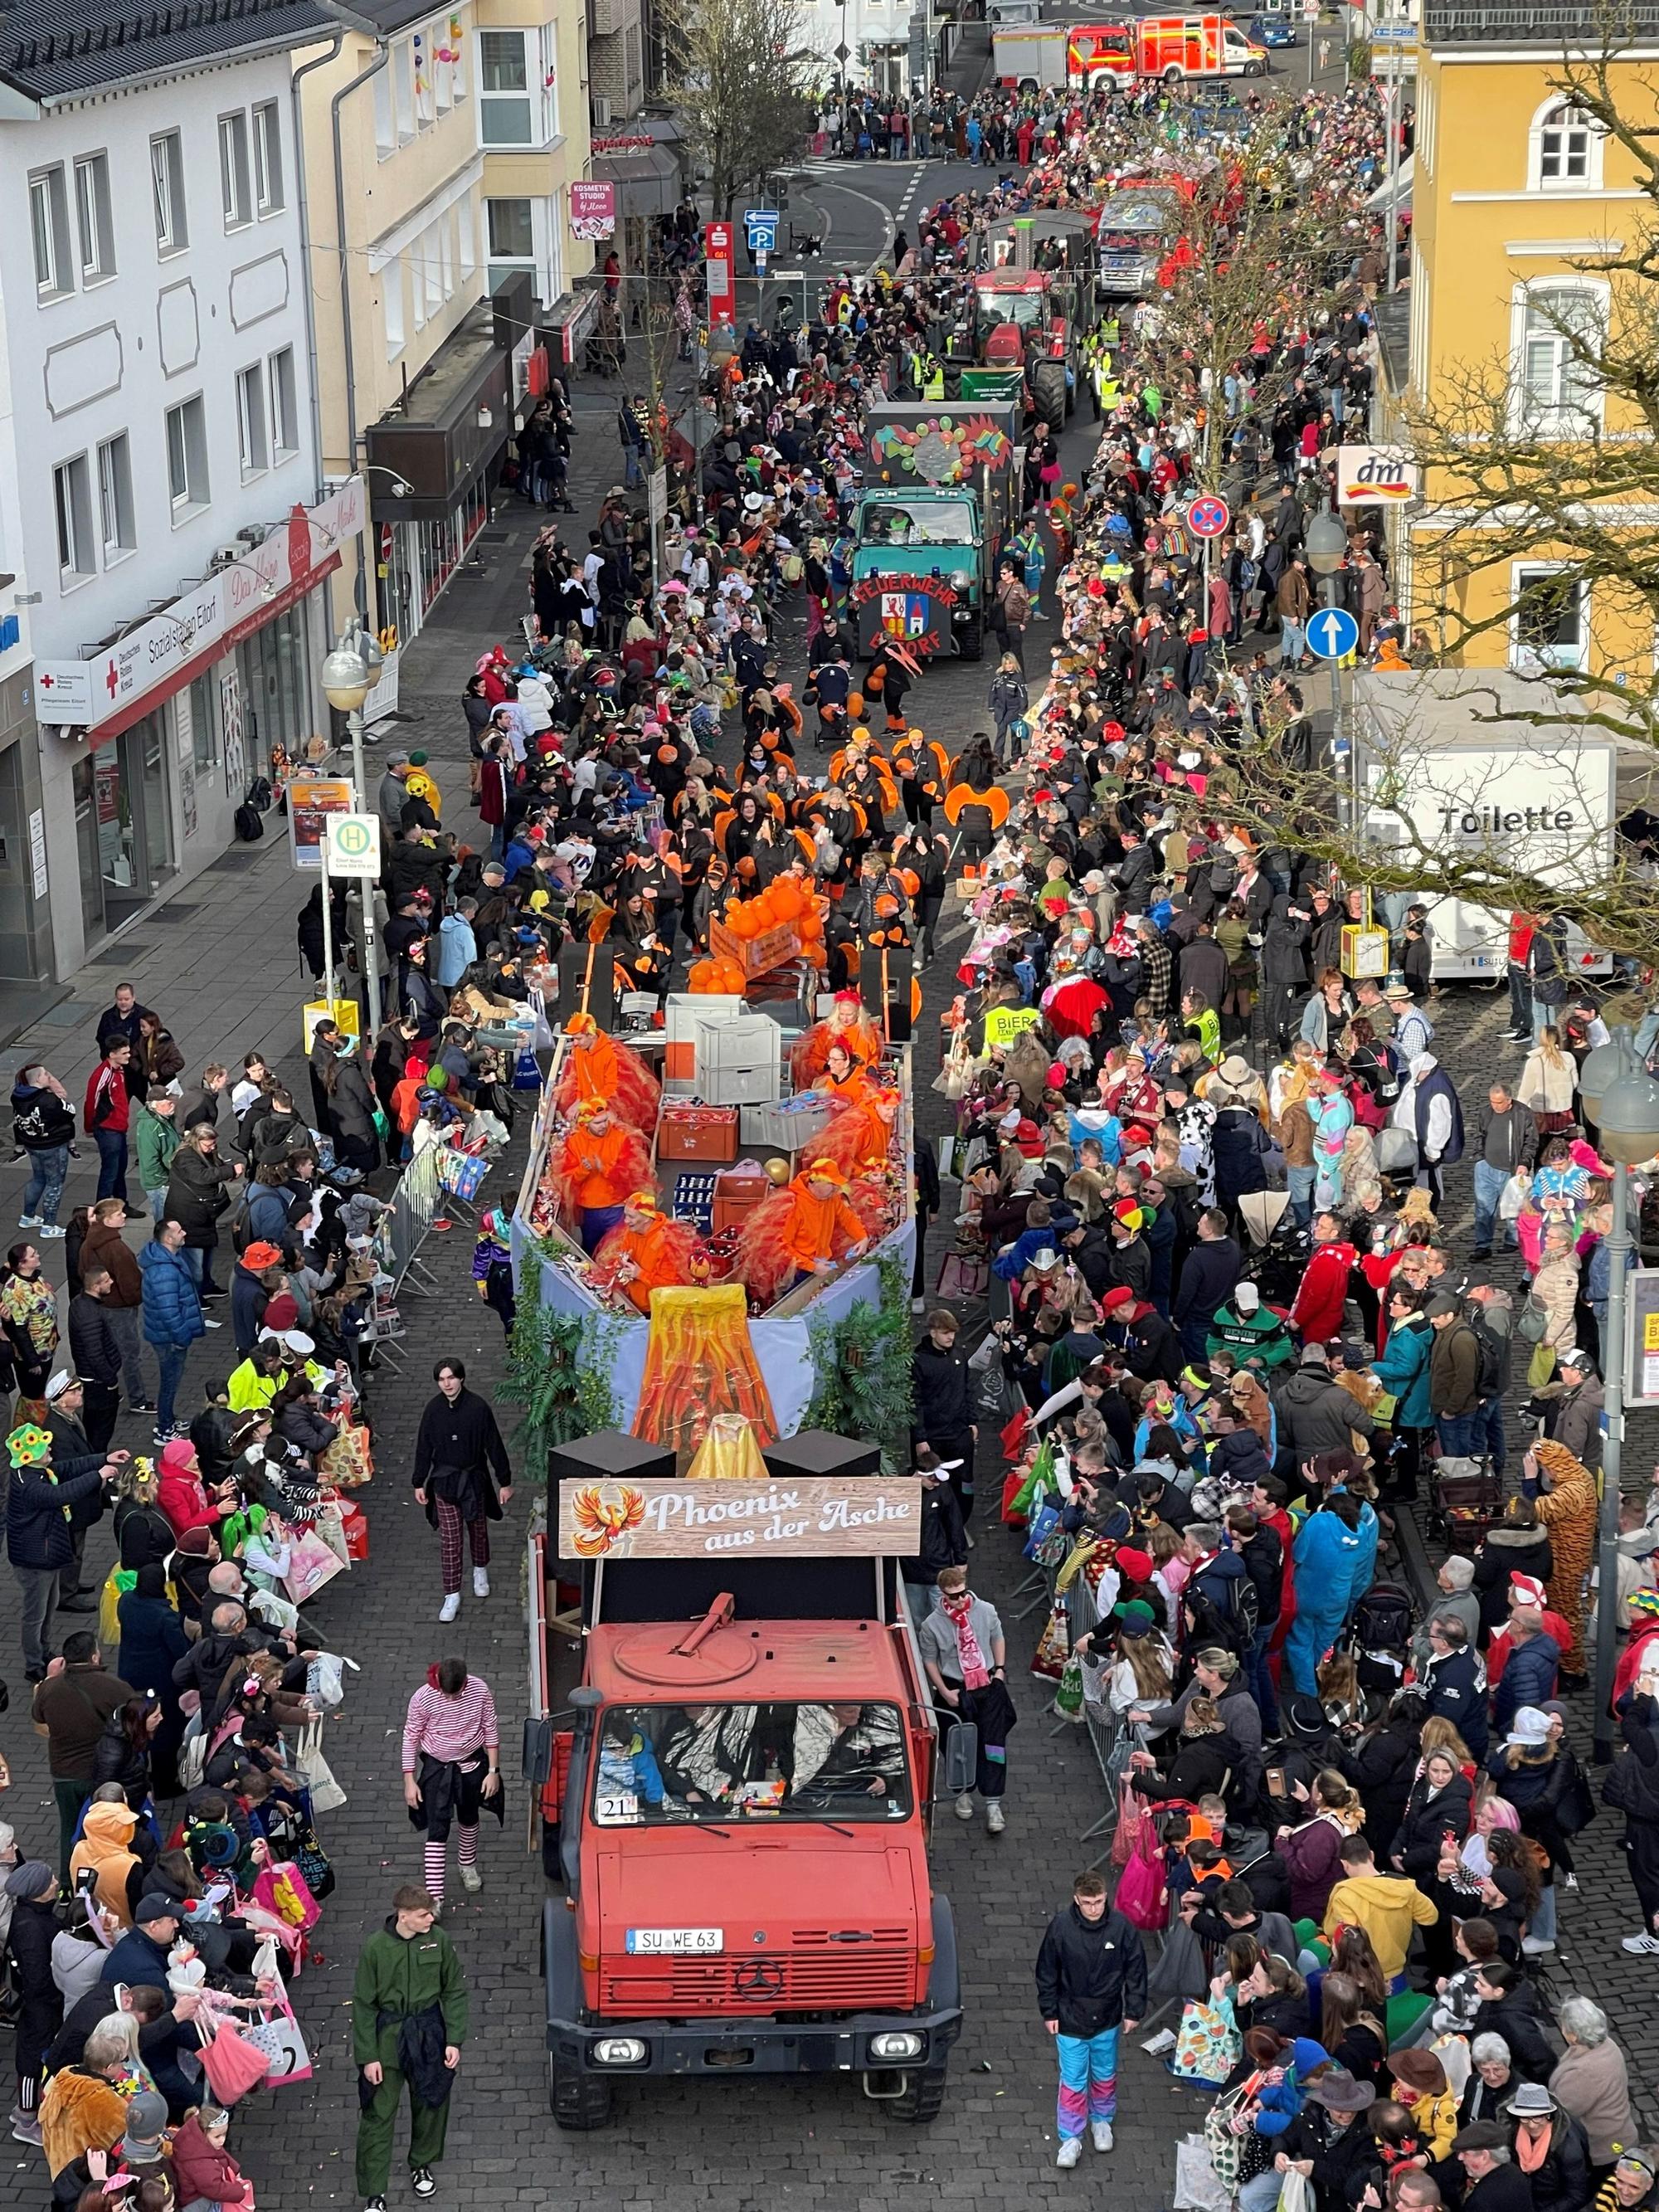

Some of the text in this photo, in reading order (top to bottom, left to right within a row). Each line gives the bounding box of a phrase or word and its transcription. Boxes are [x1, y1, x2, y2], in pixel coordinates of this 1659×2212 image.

[1357, 456, 1404, 483] dm
[854, 572, 959, 609] FEUERWEHR
[197, 595, 216, 629] Eitorf
[1438, 806, 1574, 834] Toilette
[346, 828, 360, 847] H
[997, 1016, 1030, 1029] BIER
[645, 1485, 802, 1532] Phoenix
[705, 1497, 910, 1552] aus der Asche
[603, 1800, 624, 1818] 21
[642, 1932, 715, 1947] SU WE 63
